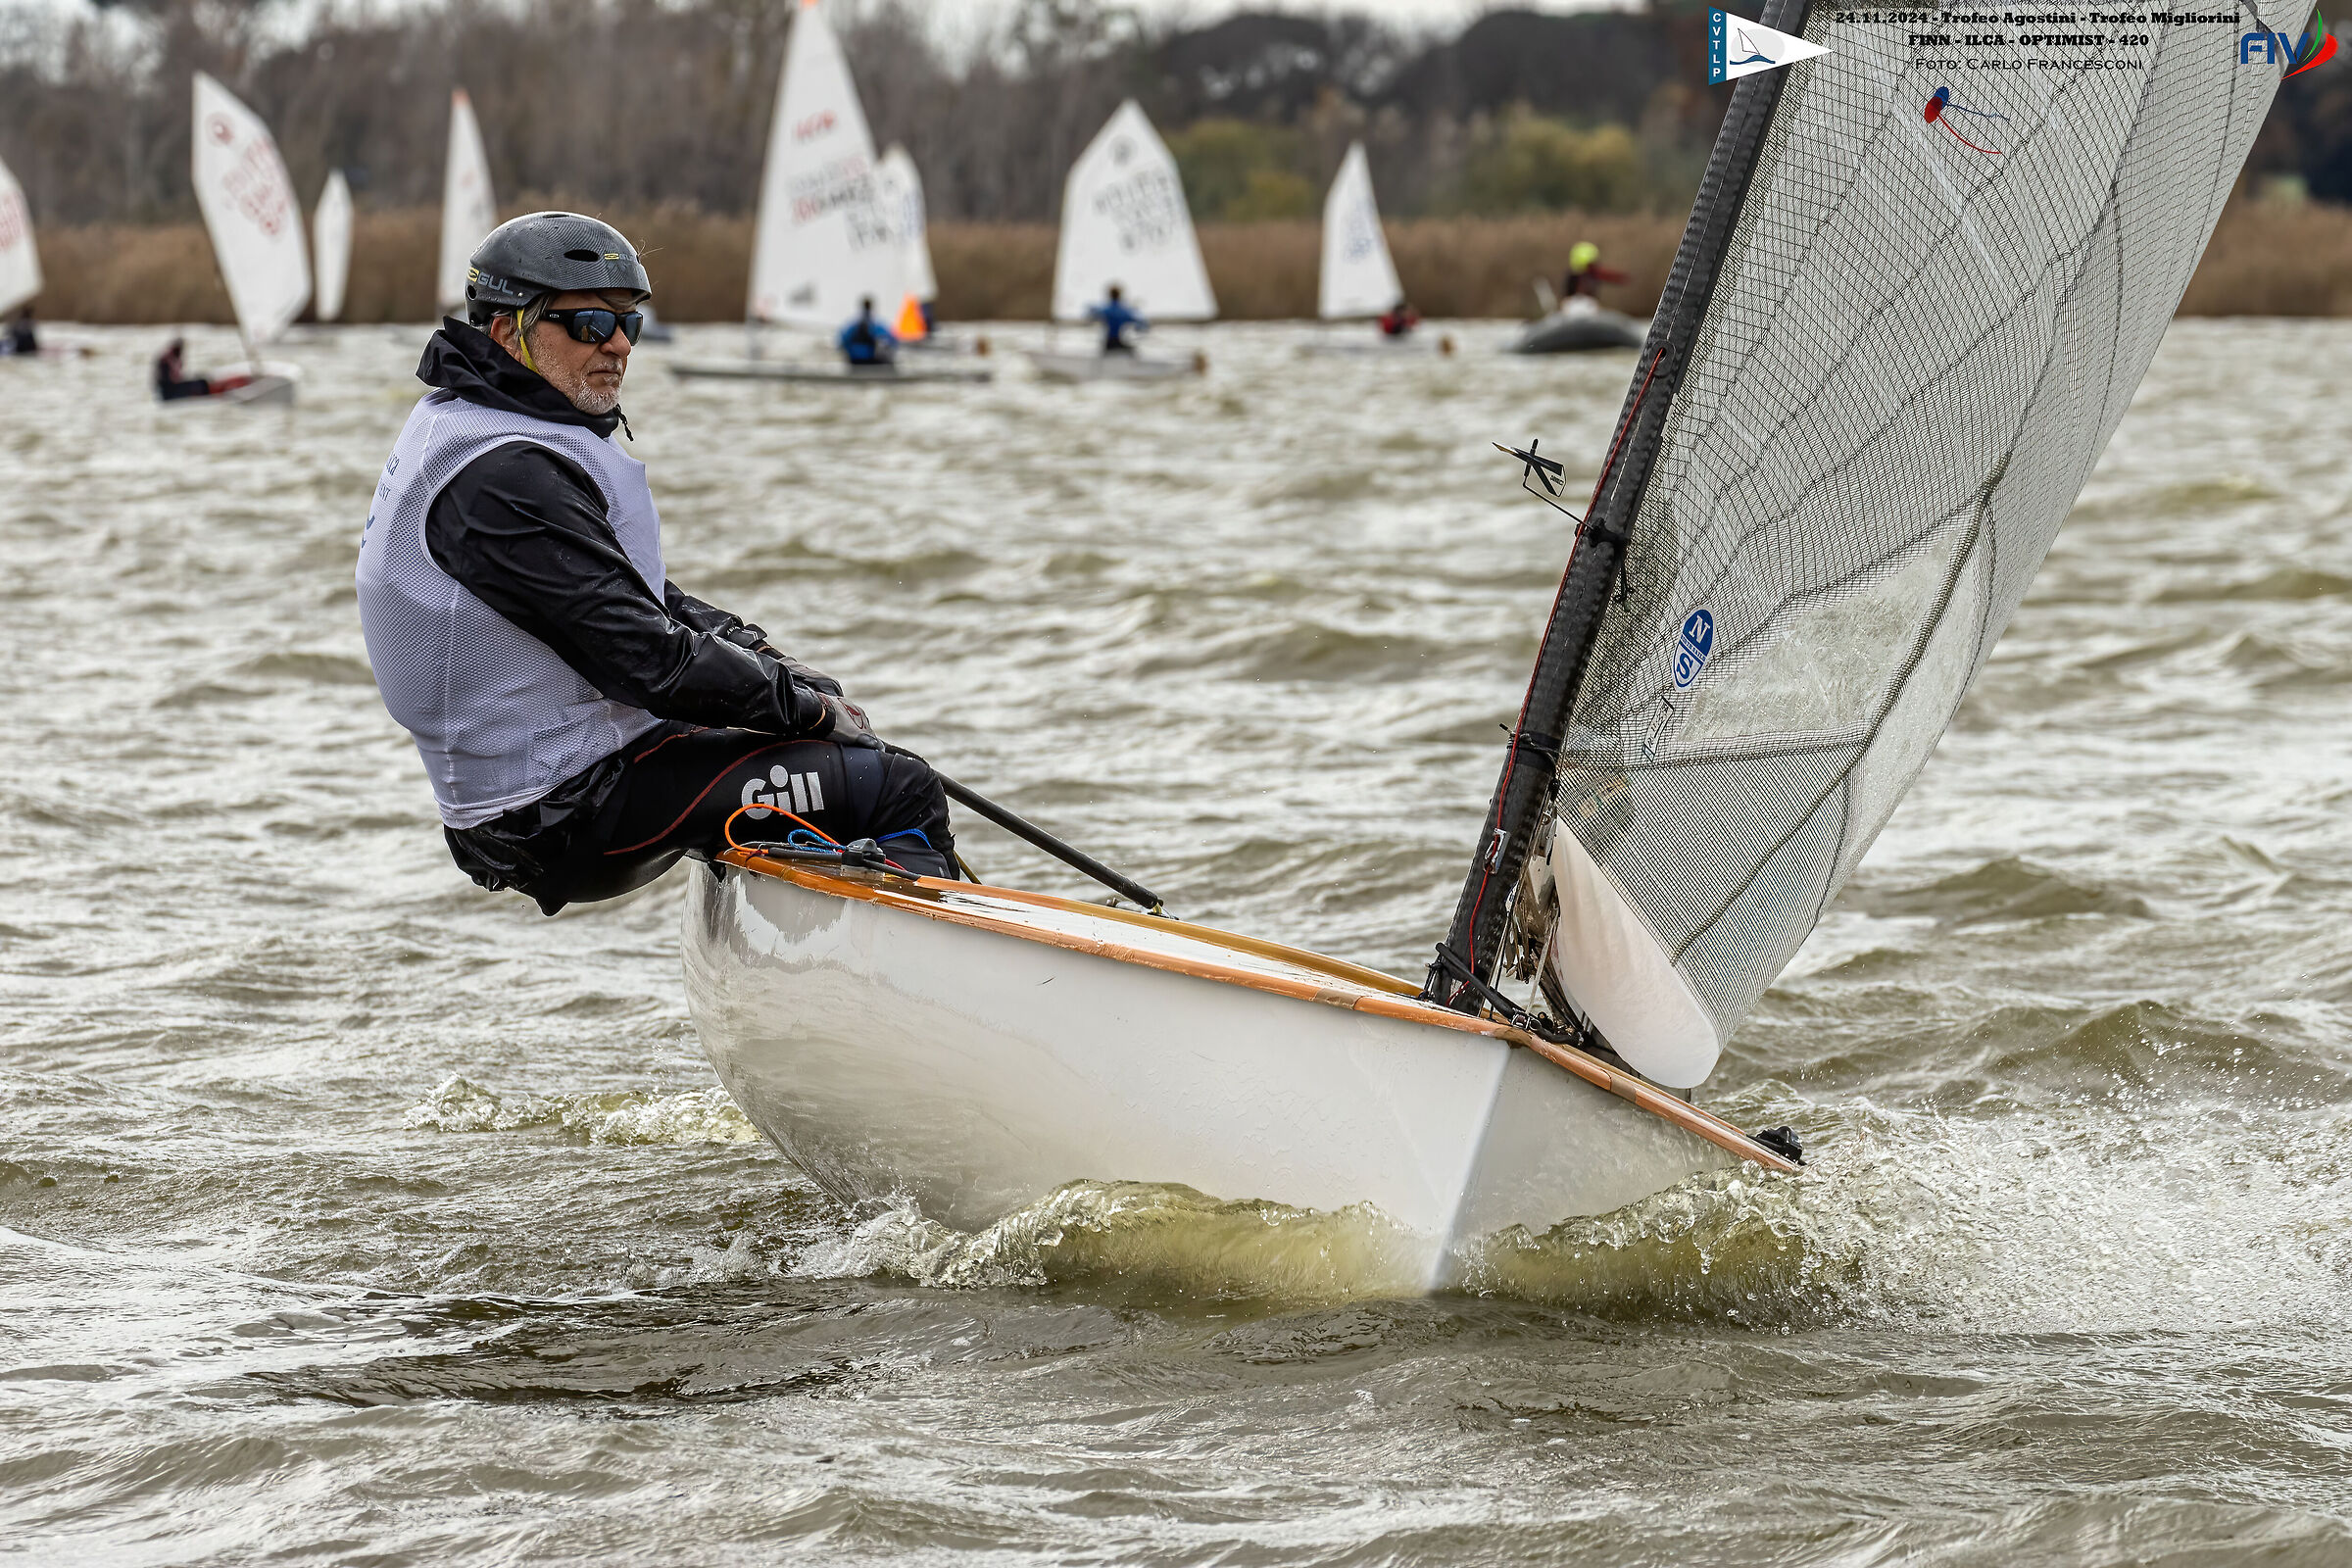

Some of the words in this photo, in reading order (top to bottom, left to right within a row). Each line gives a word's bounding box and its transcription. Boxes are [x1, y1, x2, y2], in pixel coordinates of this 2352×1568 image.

[478, 271, 514, 296] GUL
[1689, 614, 1710, 643] N
[1676, 652, 1694, 679] S
[741, 764, 824, 820] Gill
